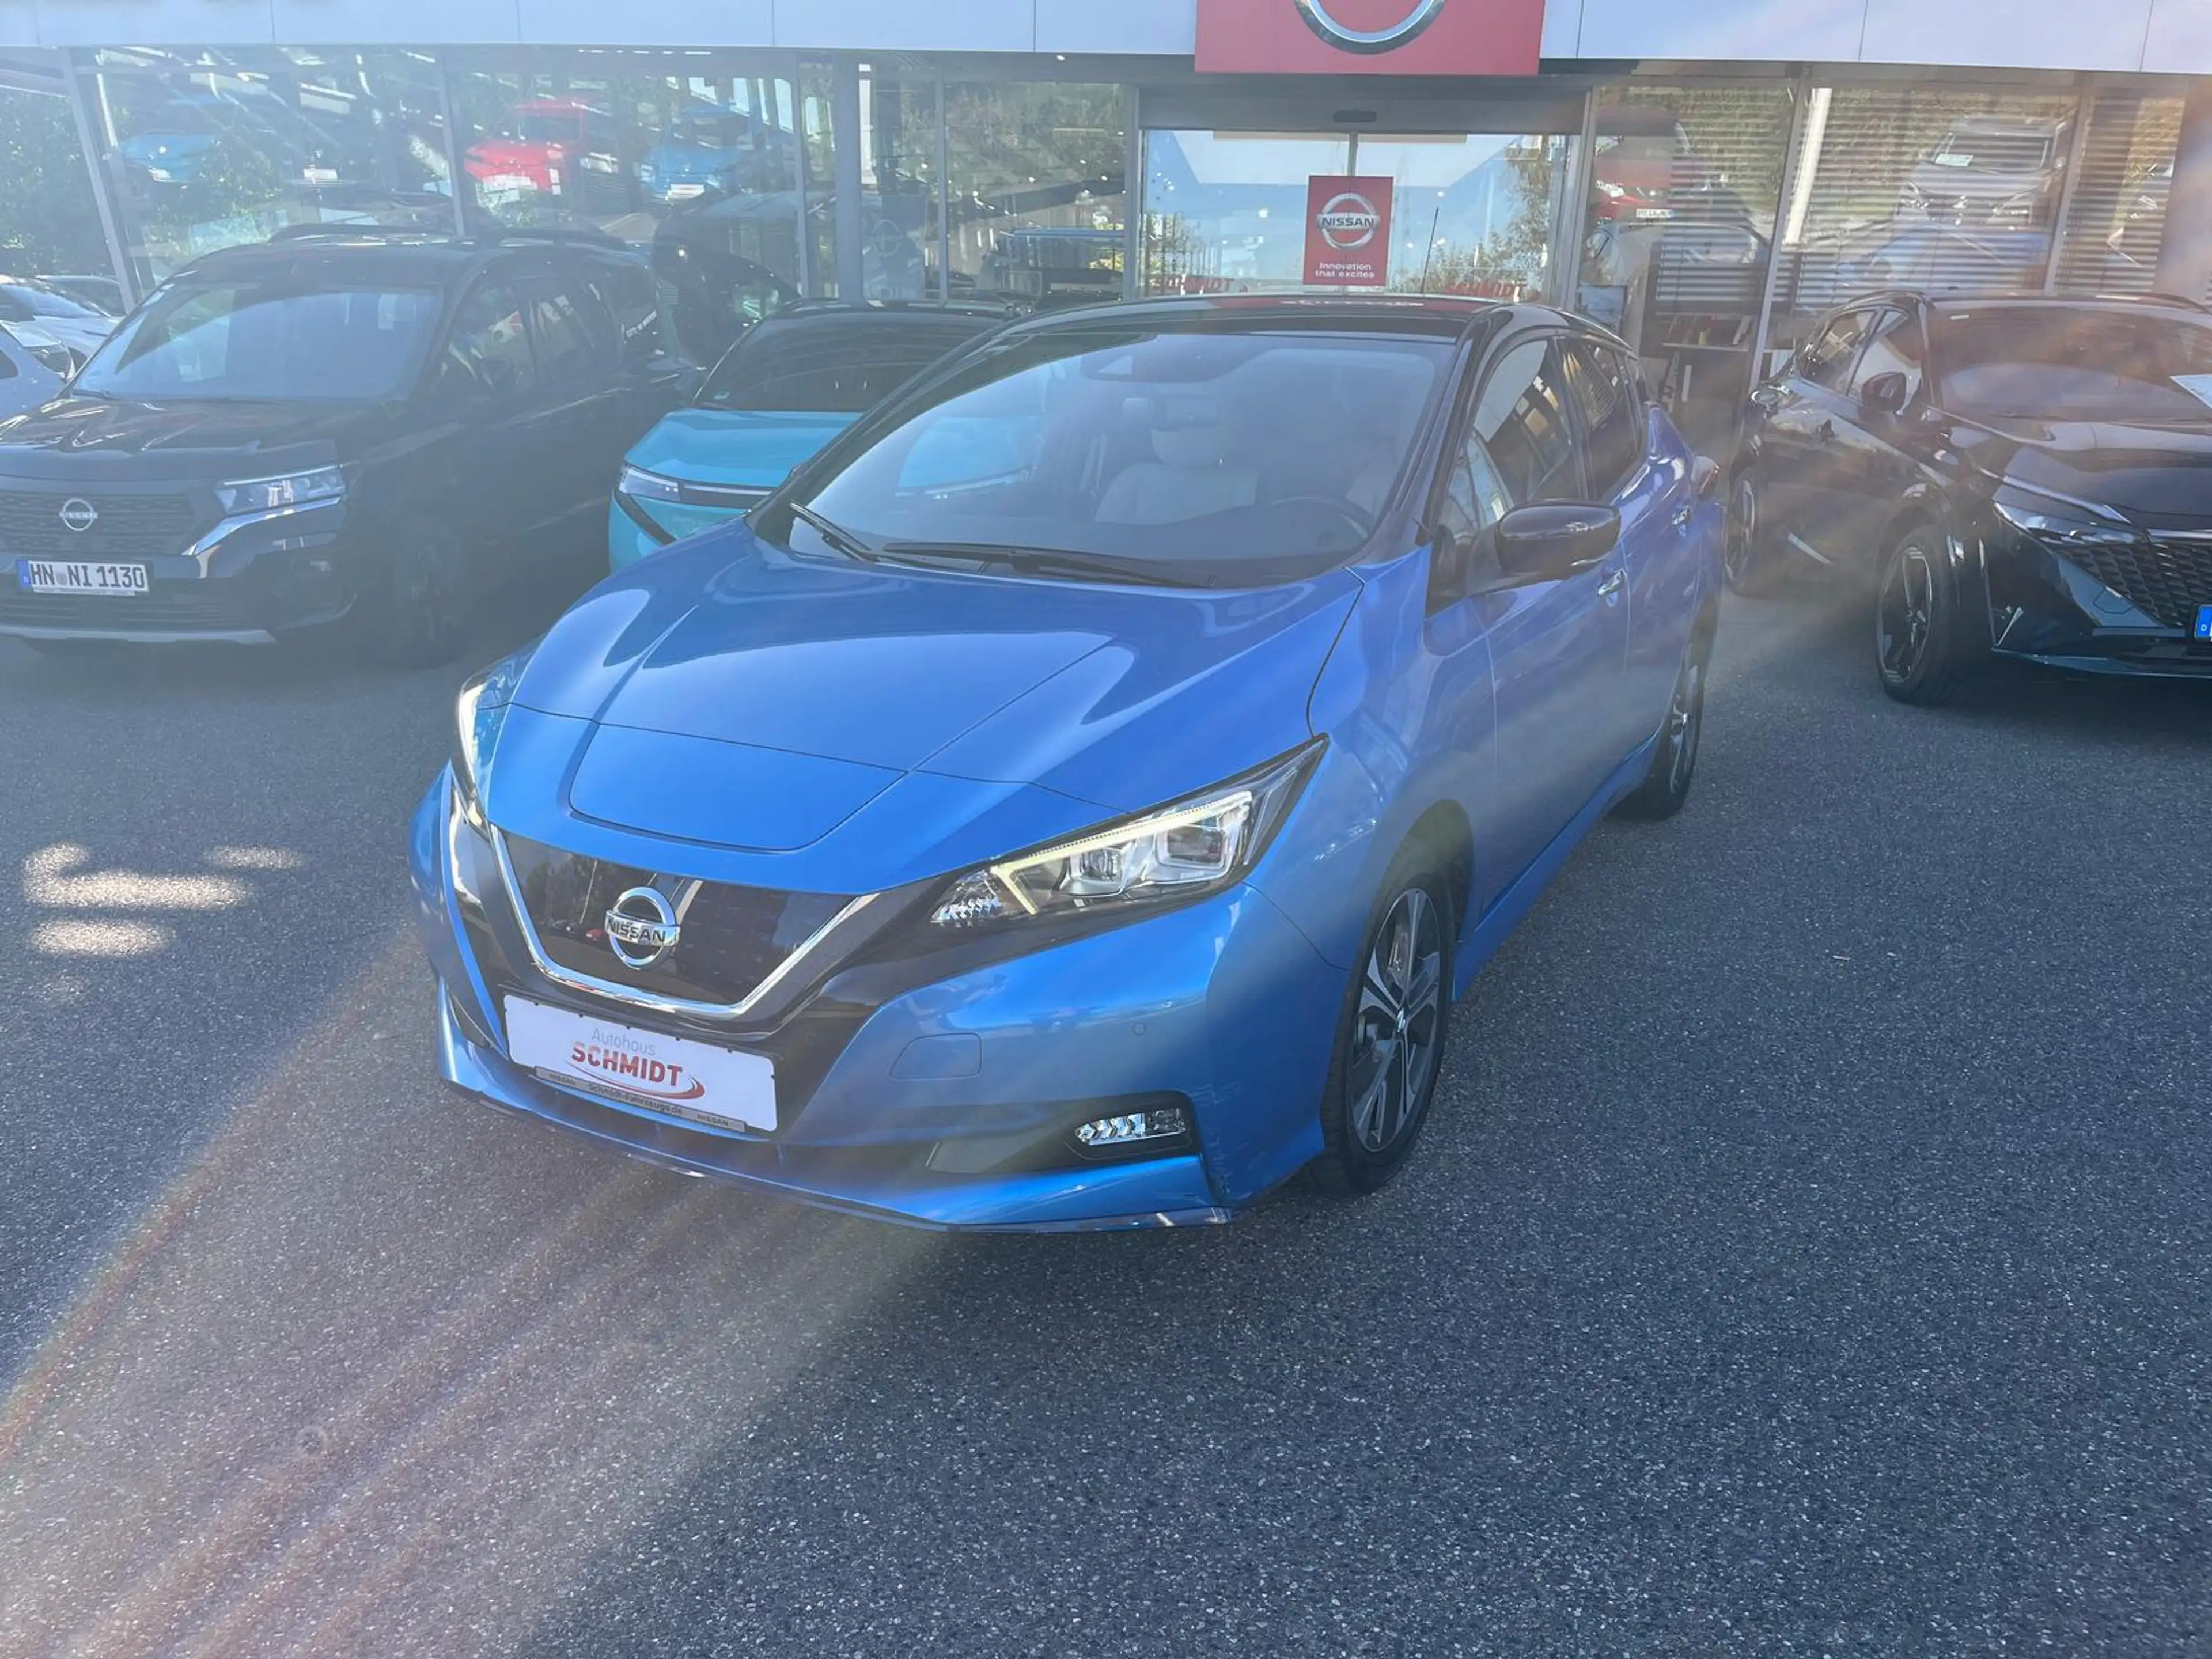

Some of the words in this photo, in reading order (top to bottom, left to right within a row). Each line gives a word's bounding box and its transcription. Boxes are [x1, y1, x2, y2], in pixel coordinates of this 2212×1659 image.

[1321, 217, 1374, 227] NISSAN
[1316, 270, 1336, 278] that
[1338, 270, 1376, 279] excites
[1319, 262, 1372, 271] Innovation
[30, 563, 56, 586] HN
[67, 565, 93, 587] NI
[96, 566, 145, 588] 1130
[607, 915, 666, 942] NISSAN
[592, 1028, 656, 1056] Autohaus
[571, 1041, 683, 1086] SCHMIDT
[696, 1113, 729, 1127] NISSAN
